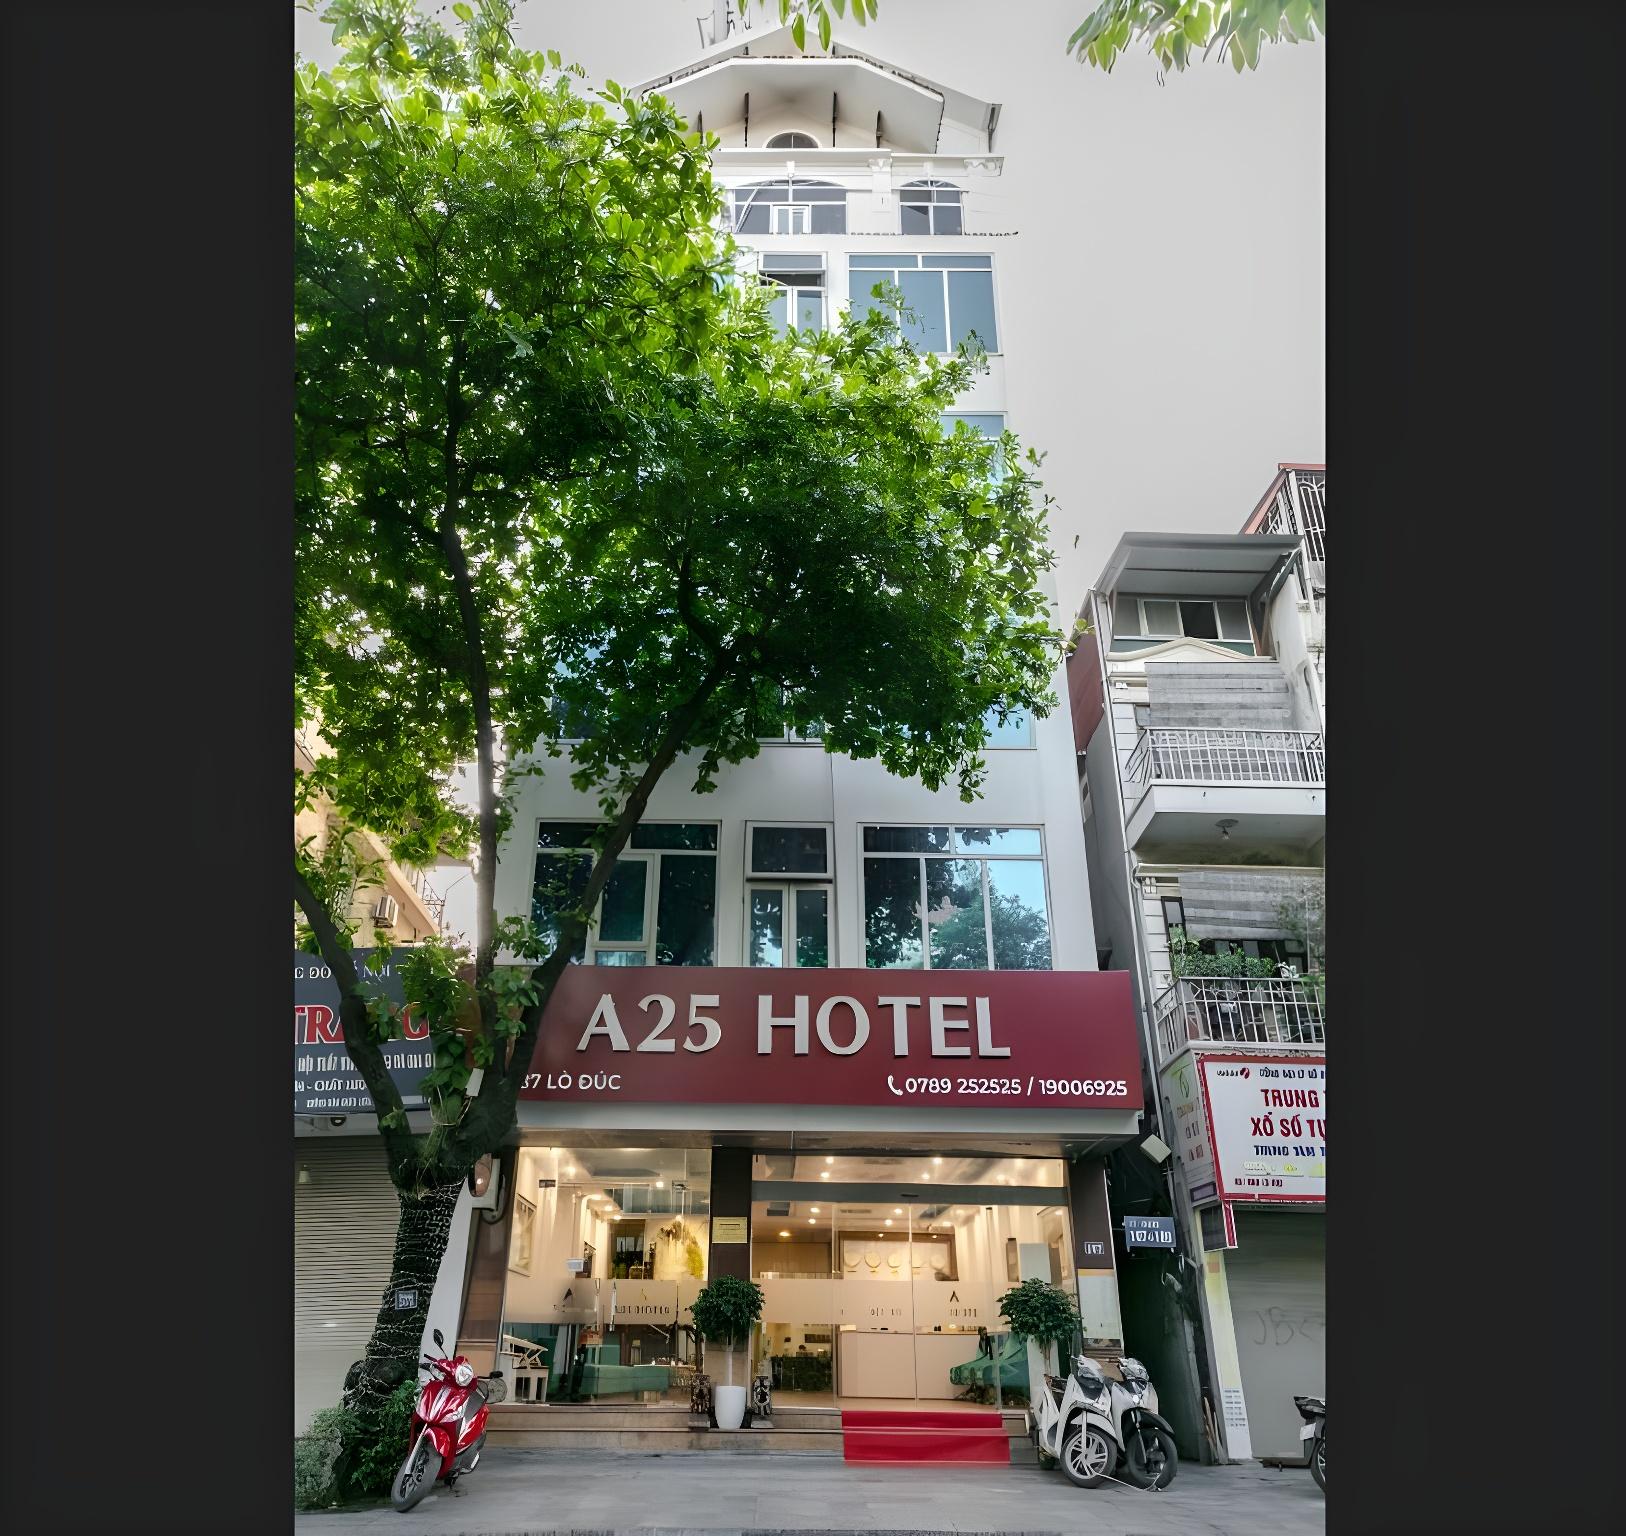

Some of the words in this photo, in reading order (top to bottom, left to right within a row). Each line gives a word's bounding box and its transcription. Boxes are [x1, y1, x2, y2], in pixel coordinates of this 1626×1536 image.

[575, 993, 722, 1053] A25
[756, 994, 1011, 1057] HOTEL
[547, 1070, 573, 1089] LÒ
[905, 1077, 952, 1094] 0789
[957, 1078, 1022, 1095] 252525
[1039, 1079, 1128, 1096] 19006925
[1260, 1088, 1320, 1108] TRUNG
[1279, 1113, 1303, 1138] SỐ
